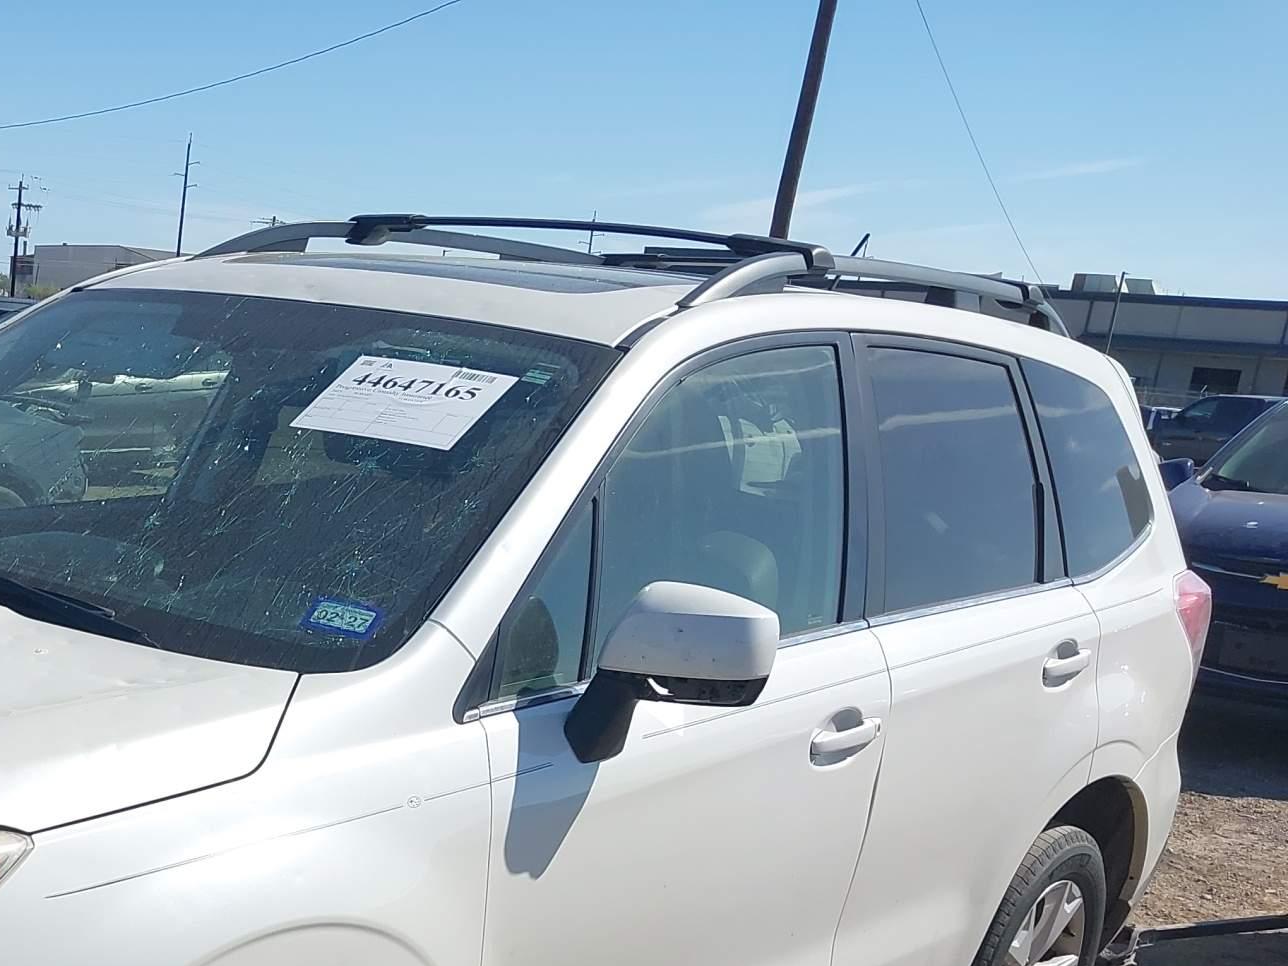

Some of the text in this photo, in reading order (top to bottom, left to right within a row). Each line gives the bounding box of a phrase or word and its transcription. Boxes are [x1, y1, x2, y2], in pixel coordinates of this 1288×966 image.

[352, 372, 483, 401] 44647165
[316, 609, 370, 629] 02 27
